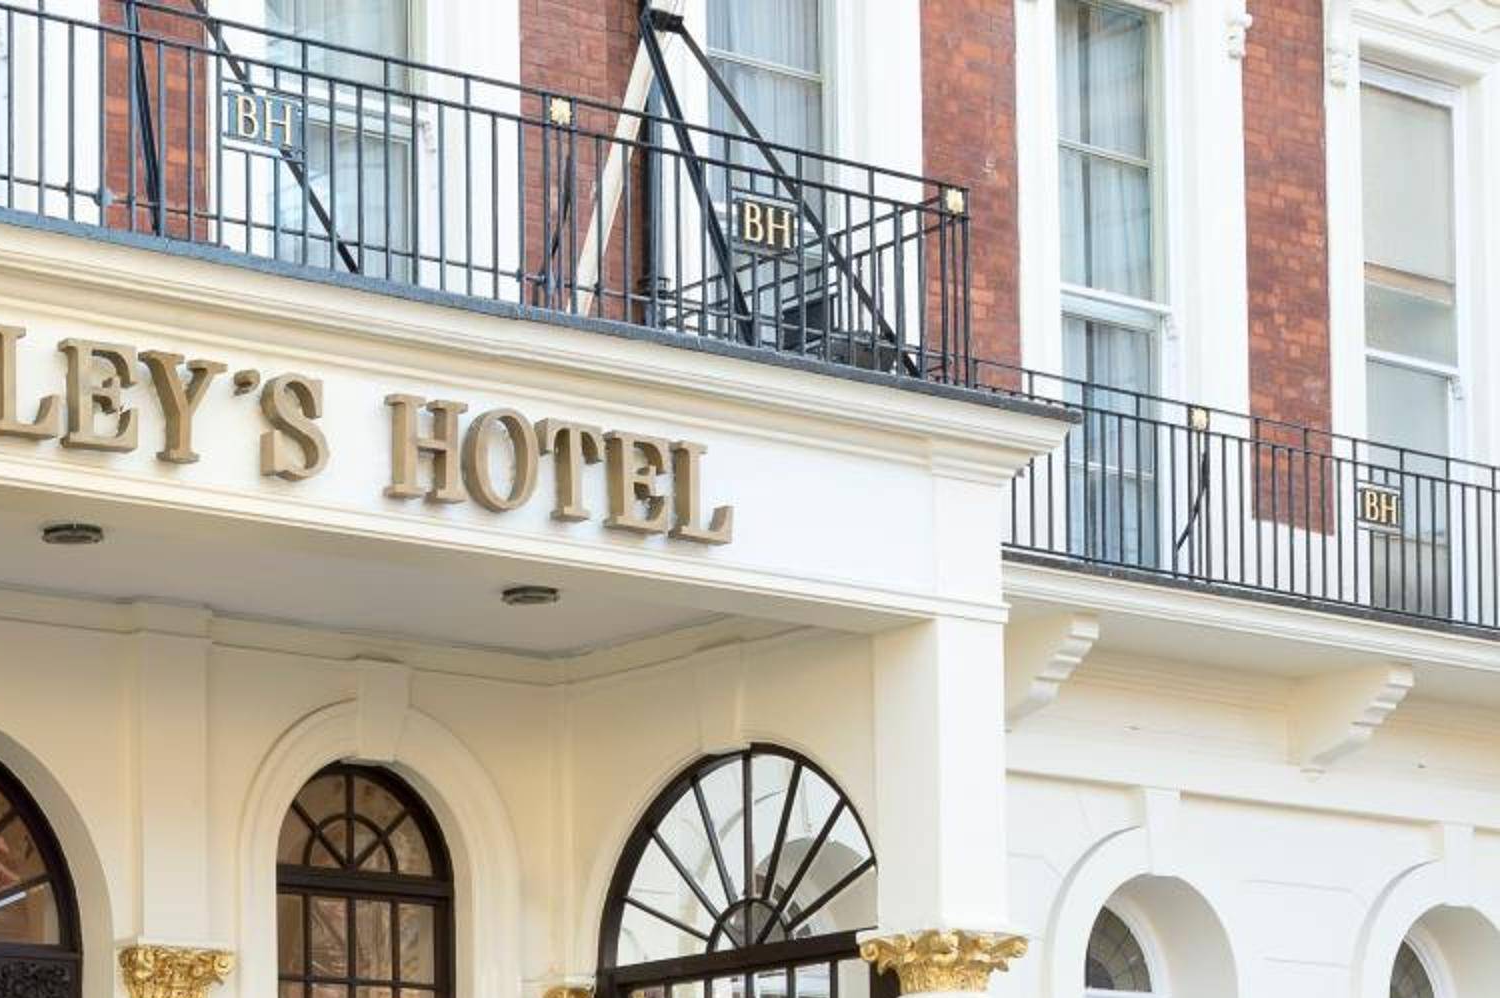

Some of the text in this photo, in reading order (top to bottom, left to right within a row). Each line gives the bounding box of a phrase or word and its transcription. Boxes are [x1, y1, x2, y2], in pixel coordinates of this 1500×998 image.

[236, 95, 293, 147] BH
[743, 201, 791, 249] BH
[383, 393, 735, 544] HOTEL
[1364, 490, 1397, 525] BH
